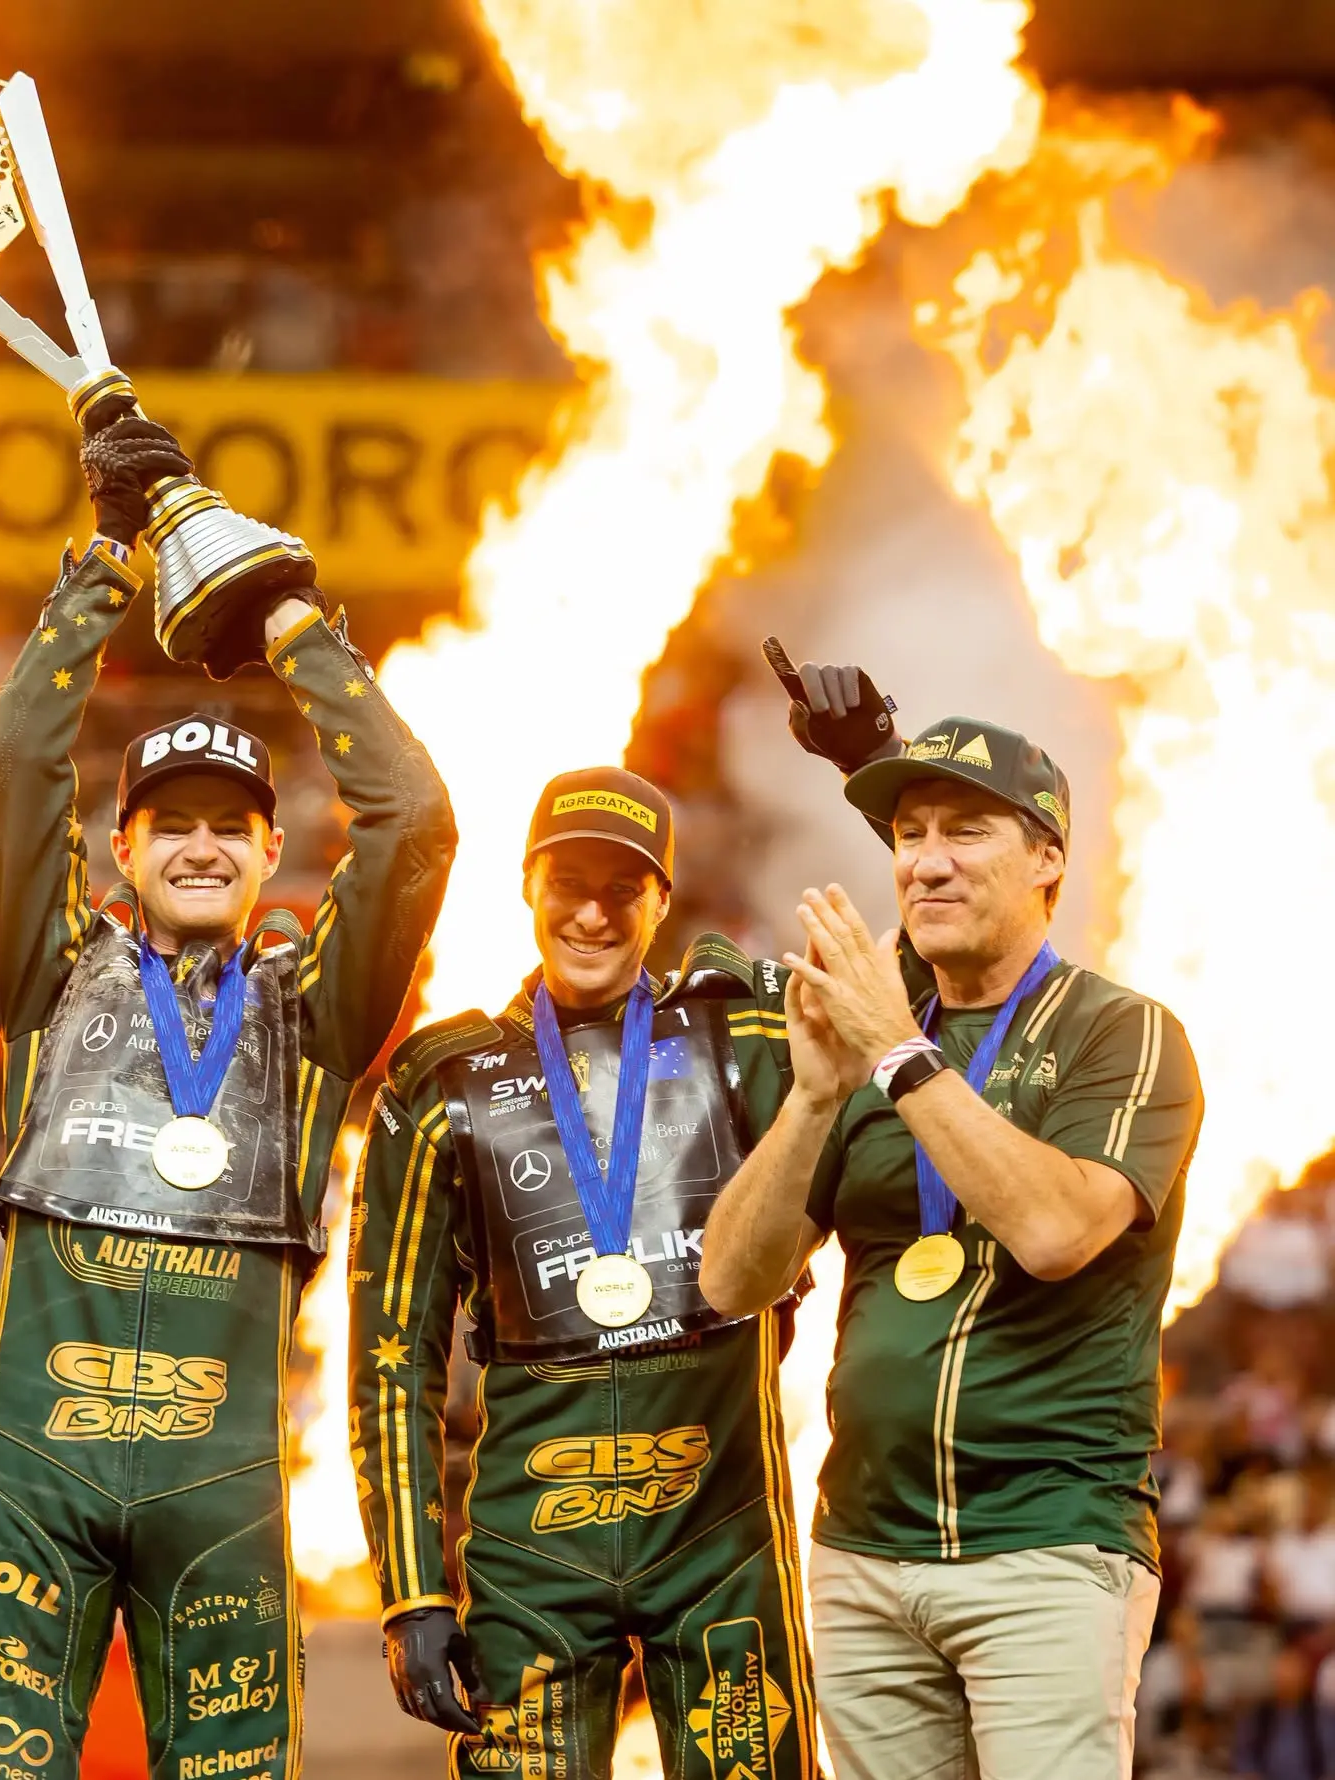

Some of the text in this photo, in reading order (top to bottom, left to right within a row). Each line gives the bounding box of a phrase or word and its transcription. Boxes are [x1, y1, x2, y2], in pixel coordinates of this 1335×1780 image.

[141, 721, 258, 768] BOLL
[674, 1007, 690, 1027] 1
[125, 1033, 161, 1053] Aut
[468, 1053, 508, 1072] FIM
[69, 1099, 128, 1114] Grupa
[490, 1076, 547, 1101] SW
[489, 1100, 532, 1118] WORLD CUP
[60, 1118, 159, 1153] FRE
[86, 1206, 173, 1232] AUSTRALIA
[96, 1235, 242, 1280] AUSTRALIA
[667, 1263, 684, 1273] Od
[147, 1273, 237, 1301] SPEEDWAY
[597, 1318, 684, 1350] AUSTRALIA
[47, 1342, 226, 1404] CBS
[46, 1398, 215, 1441] BINS
[526, 1426, 710, 1481] CBS
[532, 1472, 699, 1533] BINS
[174, 1595, 249, 1625] EASTERN
[188, 1609, 240, 1630] POINT
[187, 1649, 278, 1694] M & J
[188, 1682, 280, 1722] Sealey
[550, 1682, 565, 1747] caravans
[716, 1670, 734, 1760] SERVICES
[731, 1685, 748, 1742] ROAD
[745, 1651, 767, 1772] AUSTRALIAN
[523, 1698, 543, 1776] autocraft
[179, 1737, 280, 1780] Richard
